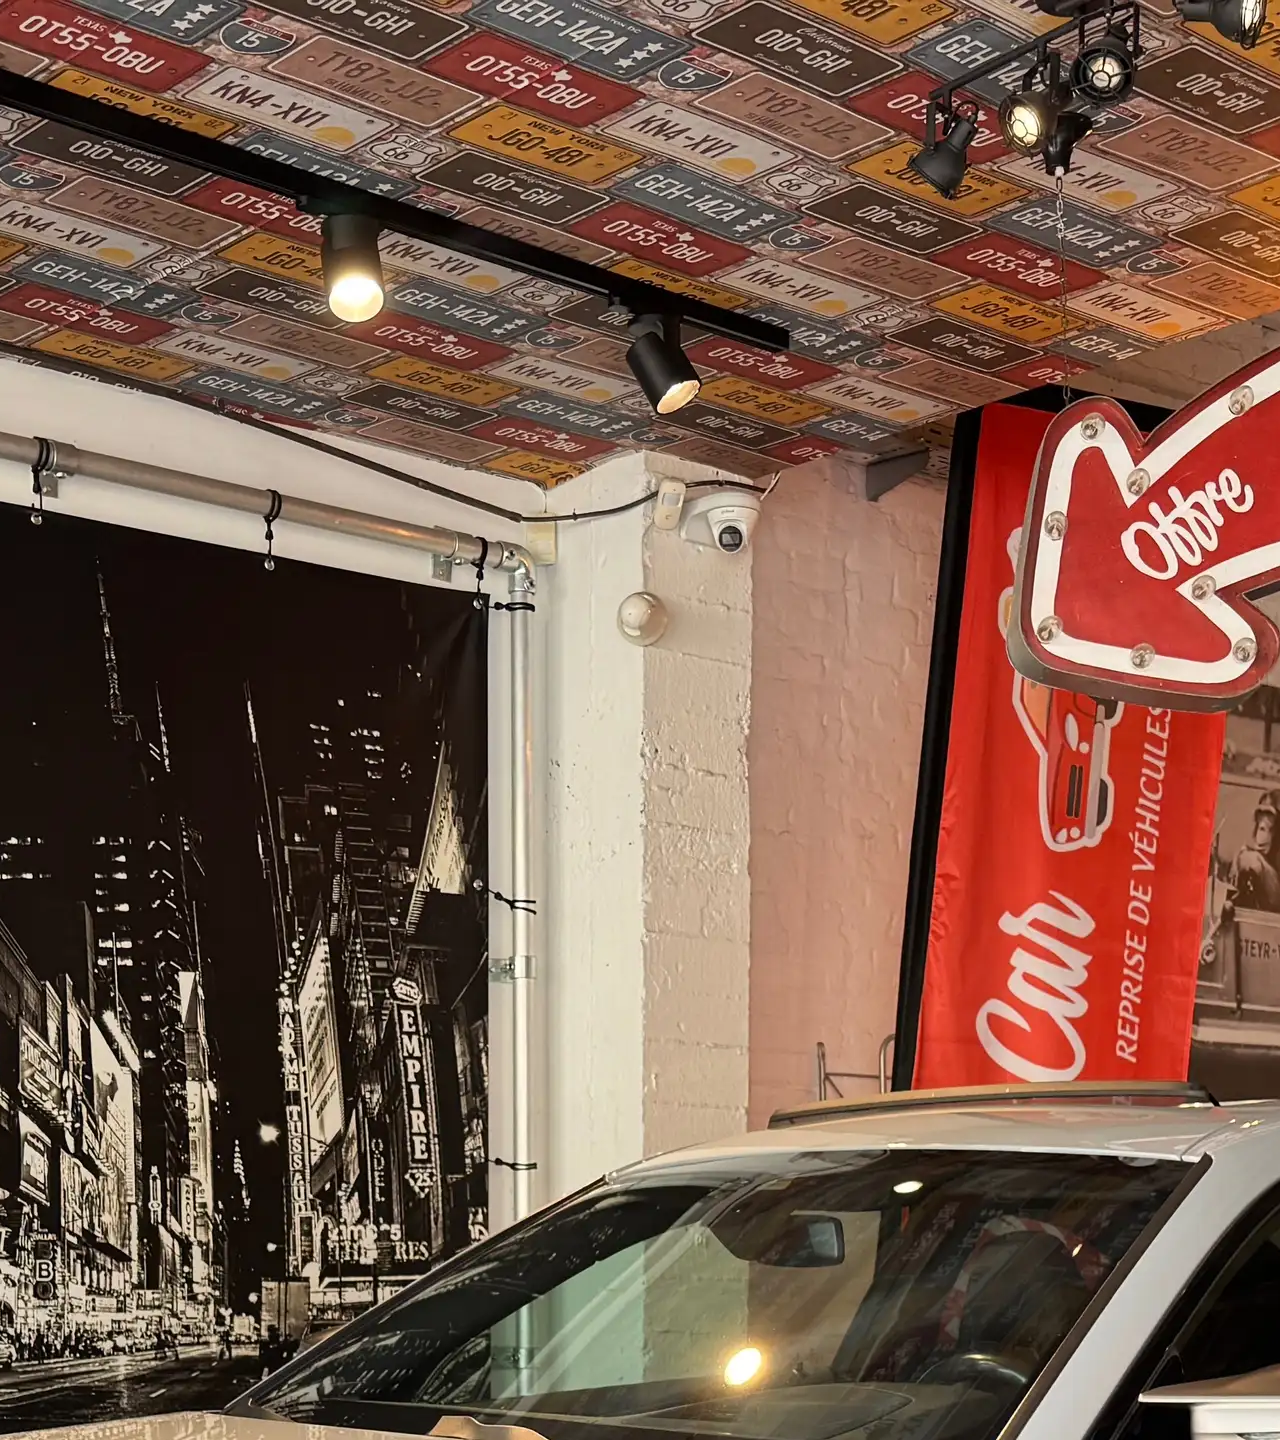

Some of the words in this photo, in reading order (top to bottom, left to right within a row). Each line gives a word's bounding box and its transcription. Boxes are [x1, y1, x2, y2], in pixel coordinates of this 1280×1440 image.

[70, 15, 107, 31] TEXAS
[490, 0, 632, 54] GEH-142A
[233, 29, 269, 49] 15
[517, 55, 552, 70] TEXAS
[669, 67, 706, 85] 15
[525, 120, 568, 137] NEW
[569, 135, 609, 151] YORK
[381, 144, 417, 160] 66
[9, 171, 41, 186] 15
[775, 176, 812, 191] 66
[629, 174, 750, 220] GEH-142A
[1151, 204, 1187, 219] 66
[778, 232, 810, 246] 15
[1005, 204, 1117, 248] GEH-142A
[1134, 257, 1167, 270] 15
[390, 288, 503, 325] GEH-142A
[863, 312, 896, 324] 66
[193, 375, 300, 406] GEH-142A
[511, 398, 611, 428] GEH-142A
[1121, 466, 1253, 580] Offre
[1128, 706, 1173, 874] VÉHICULES
[1137, 879, 1152, 927] DE
[976, 889, 1096, 1082] Car
[1116, 929, 1148, 1063] REPRISE
[399, 1009, 429, 1160] EMPIRE
[414, 1172, 431, 1187] 25
